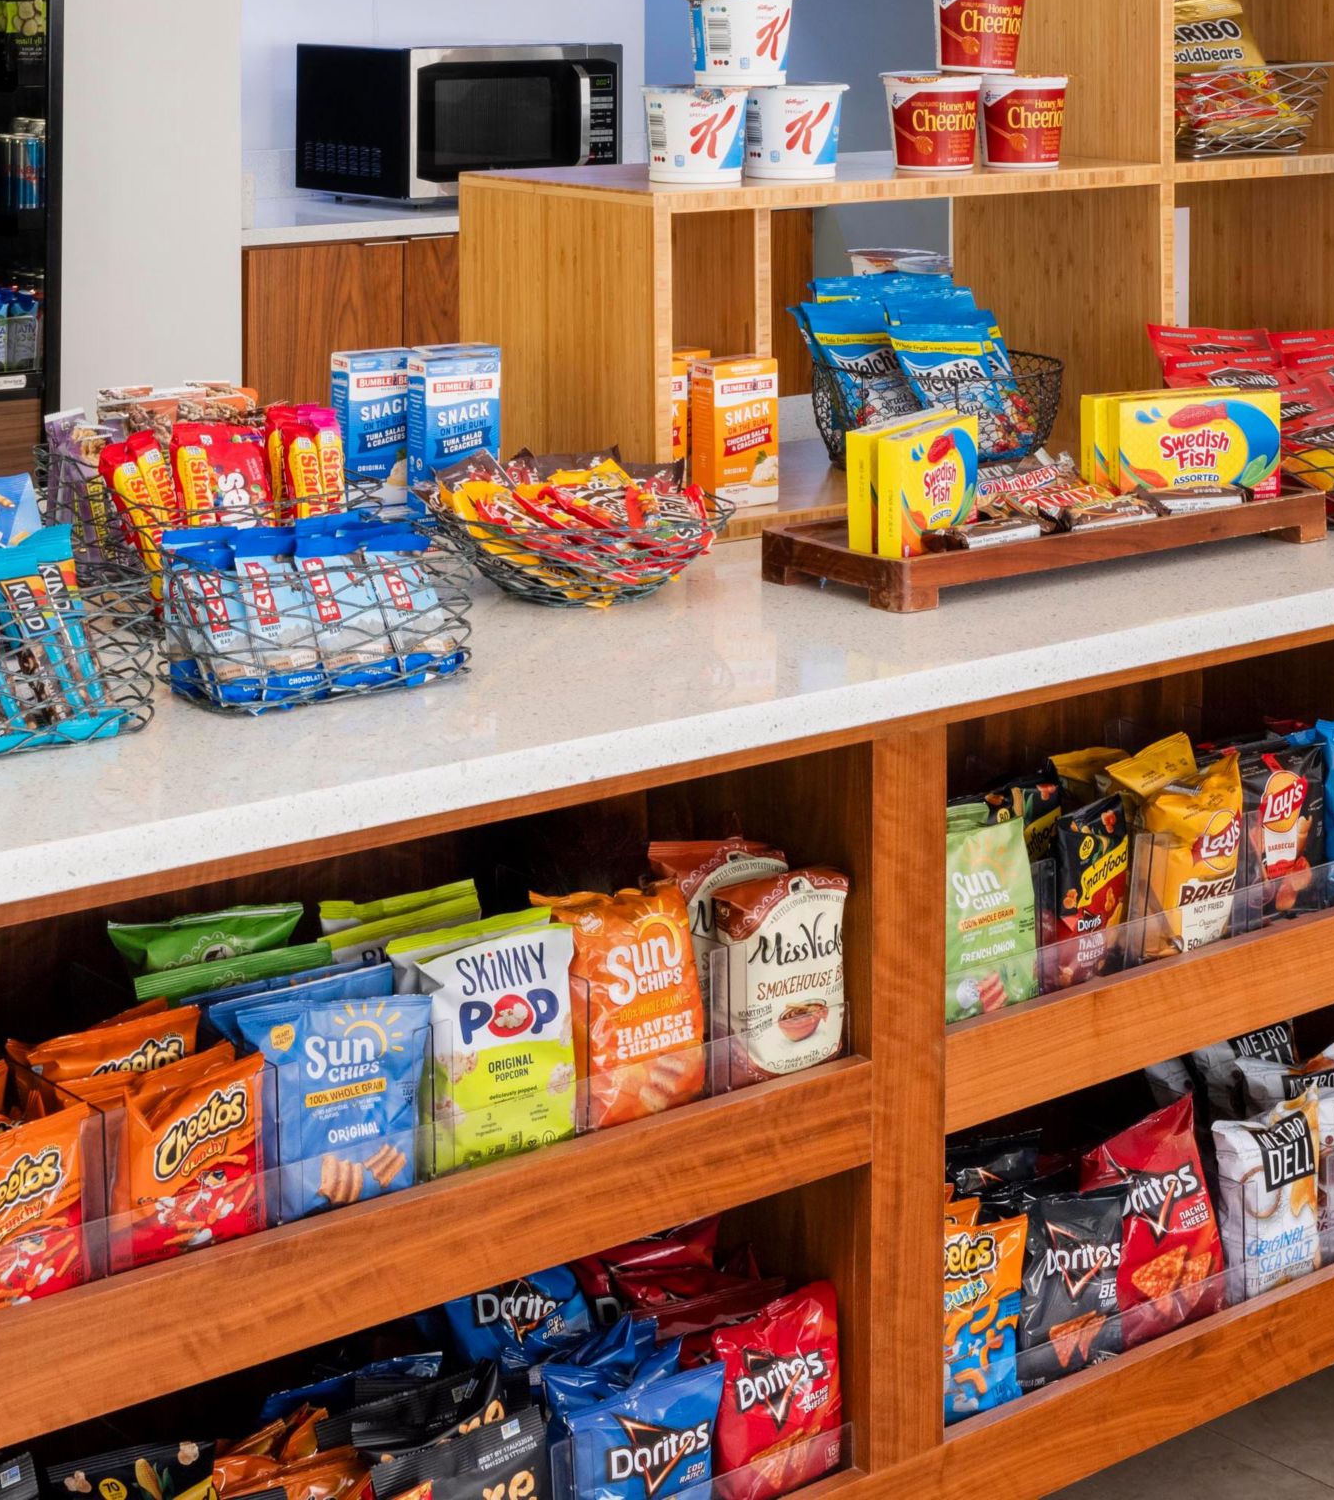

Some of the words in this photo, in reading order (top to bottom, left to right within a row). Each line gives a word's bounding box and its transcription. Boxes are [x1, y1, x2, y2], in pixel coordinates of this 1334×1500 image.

[988, 4, 1011, 16] Honey
[960, 9, 1021, 35] Cheerios
[1174, 20, 1240, 42] ARIBO
[756, 8, 790, 61] K
[939, 102, 965, 113] Honey
[1035, 99, 1057, 110] Honey
[785, 102, 830, 154] K
[912, 109, 976, 132] Cheerios
[690, 105, 735, 159] K
[359, 376, 392, 387] BUMBLE
[436, 381, 467, 391] BUMBLE
[474, 379, 490, 389] BEE
[723, 383, 751, 393] BUMBLE
[758, 380, 772, 389] BEE
[917, 362, 984, 394] Welch's
[437, 402, 490, 426] SNACK
[725, 401, 770, 426] SNACK
[366, 431, 383, 441] TUNA
[385, 426, 406, 437] SALAD
[440, 428, 451, 436] ON
[453, 425, 466, 434] THE
[468, 419, 487, 431] RUN!
[727, 433, 751, 446] CHICKEN
[751, 428, 769, 438] SALAD
[373, 433, 406, 447] CRACKERS
[443, 437, 460, 447] TUNA
[462, 431, 483, 442] SALAD
[449, 439, 483, 453] CRACKERS
[737, 436, 765, 450] CRACKERS
[1160, 430, 1230, 459] Swedish
[357, 464, 386, 472] ORIGINAL
[1177, 449, 1216, 470] Fish
[724, 467, 748, 475] ORIGINAL
[923, 462, 957, 496] Swedish
[992, 464, 1060, 492] Musketeers
[1174, 473, 1219, 485] ASSORTED
[932, 485, 952, 506] Fish
[929, 509, 953, 524] ASSORTED
[40, 565, 71, 611] KIND
[11, 584, 45, 631] KIND
[321, 606, 338, 616] BAR
[261, 624, 282, 633] ENERGY
[289, 673, 325, 686] CHOCOLATE
[1262, 781, 1304, 823] Lay's
[1082, 839, 1092, 850] 80
[1201, 818, 1241, 858] Lay's
[1268, 842, 1295, 852] BARBECUE
[1083, 850, 1127, 901] Smartfood
[952, 869, 1001, 910] Sun
[972, 891, 1009, 911] CHIPS
[1193, 904, 1207, 914] NOT
[1208, 901, 1224, 911] FRIED
[961, 920, 977, 930] 100%
[977, 915, 996, 927] WHOLE
[998, 909, 1014, 920] GRAIN
[748, 931, 807, 966] Miss
[960, 947, 991, 966] FRENCH
[1077, 947, 1105, 961] CHEESE
[606, 936, 682, 1006] Sun
[638, 967, 682, 994] CHIPS
[757, 970, 832, 1001] SMOKEHOUSE
[459, 988, 559, 1045] POP
[639, 1002, 661, 1018] WHOLE
[661, 994, 683, 1012] GRAIN
[617, 1010, 693, 1046] HARVEST
[617, 1025, 695, 1060] CHEDDAR
[1236, 1025, 1288, 1056] METRO
[305, 1036, 375, 1080] Sun
[488, 1053, 534, 1074] ORIGINAL
[328, 1060, 380, 1083] CHIPS
[495, 1069, 529, 1083] POPCORN
[309, 1093, 329, 1105] 100%
[330, 1086, 360, 1101] WHOLE
[362, 1081, 384, 1093] GRAIN
[489, 1090, 517, 1101] deliciously
[156, 1090, 246, 1181] Cheetos
[1257, 1117, 1305, 1149] METRO
[180, 1136, 227, 1177] Crunchy
[1179, 1202, 1206, 1220] NACHO
[1181, 1211, 1210, 1229] CHEESE
[1247, 1225, 1304, 1257] ORIGINAL
[1047, 1244, 1120, 1276] Doritos
[1259, 1254, 1282, 1274] SEA
[1285, 1239, 1313, 1266] SALT
[737, 1350, 824, 1411] Doritos
[802, 1385, 829, 1405] NACHO
[803, 1394, 829, 1413] CHEESE
[478, 1454, 493, 1465] BEST
[495, 1449, 502, 1458] BY
[611, 1421, 709, 1481] Doritos
[679, 1470, 706, 1484] RANCH
[103, 1480, 120, 1496] 70
